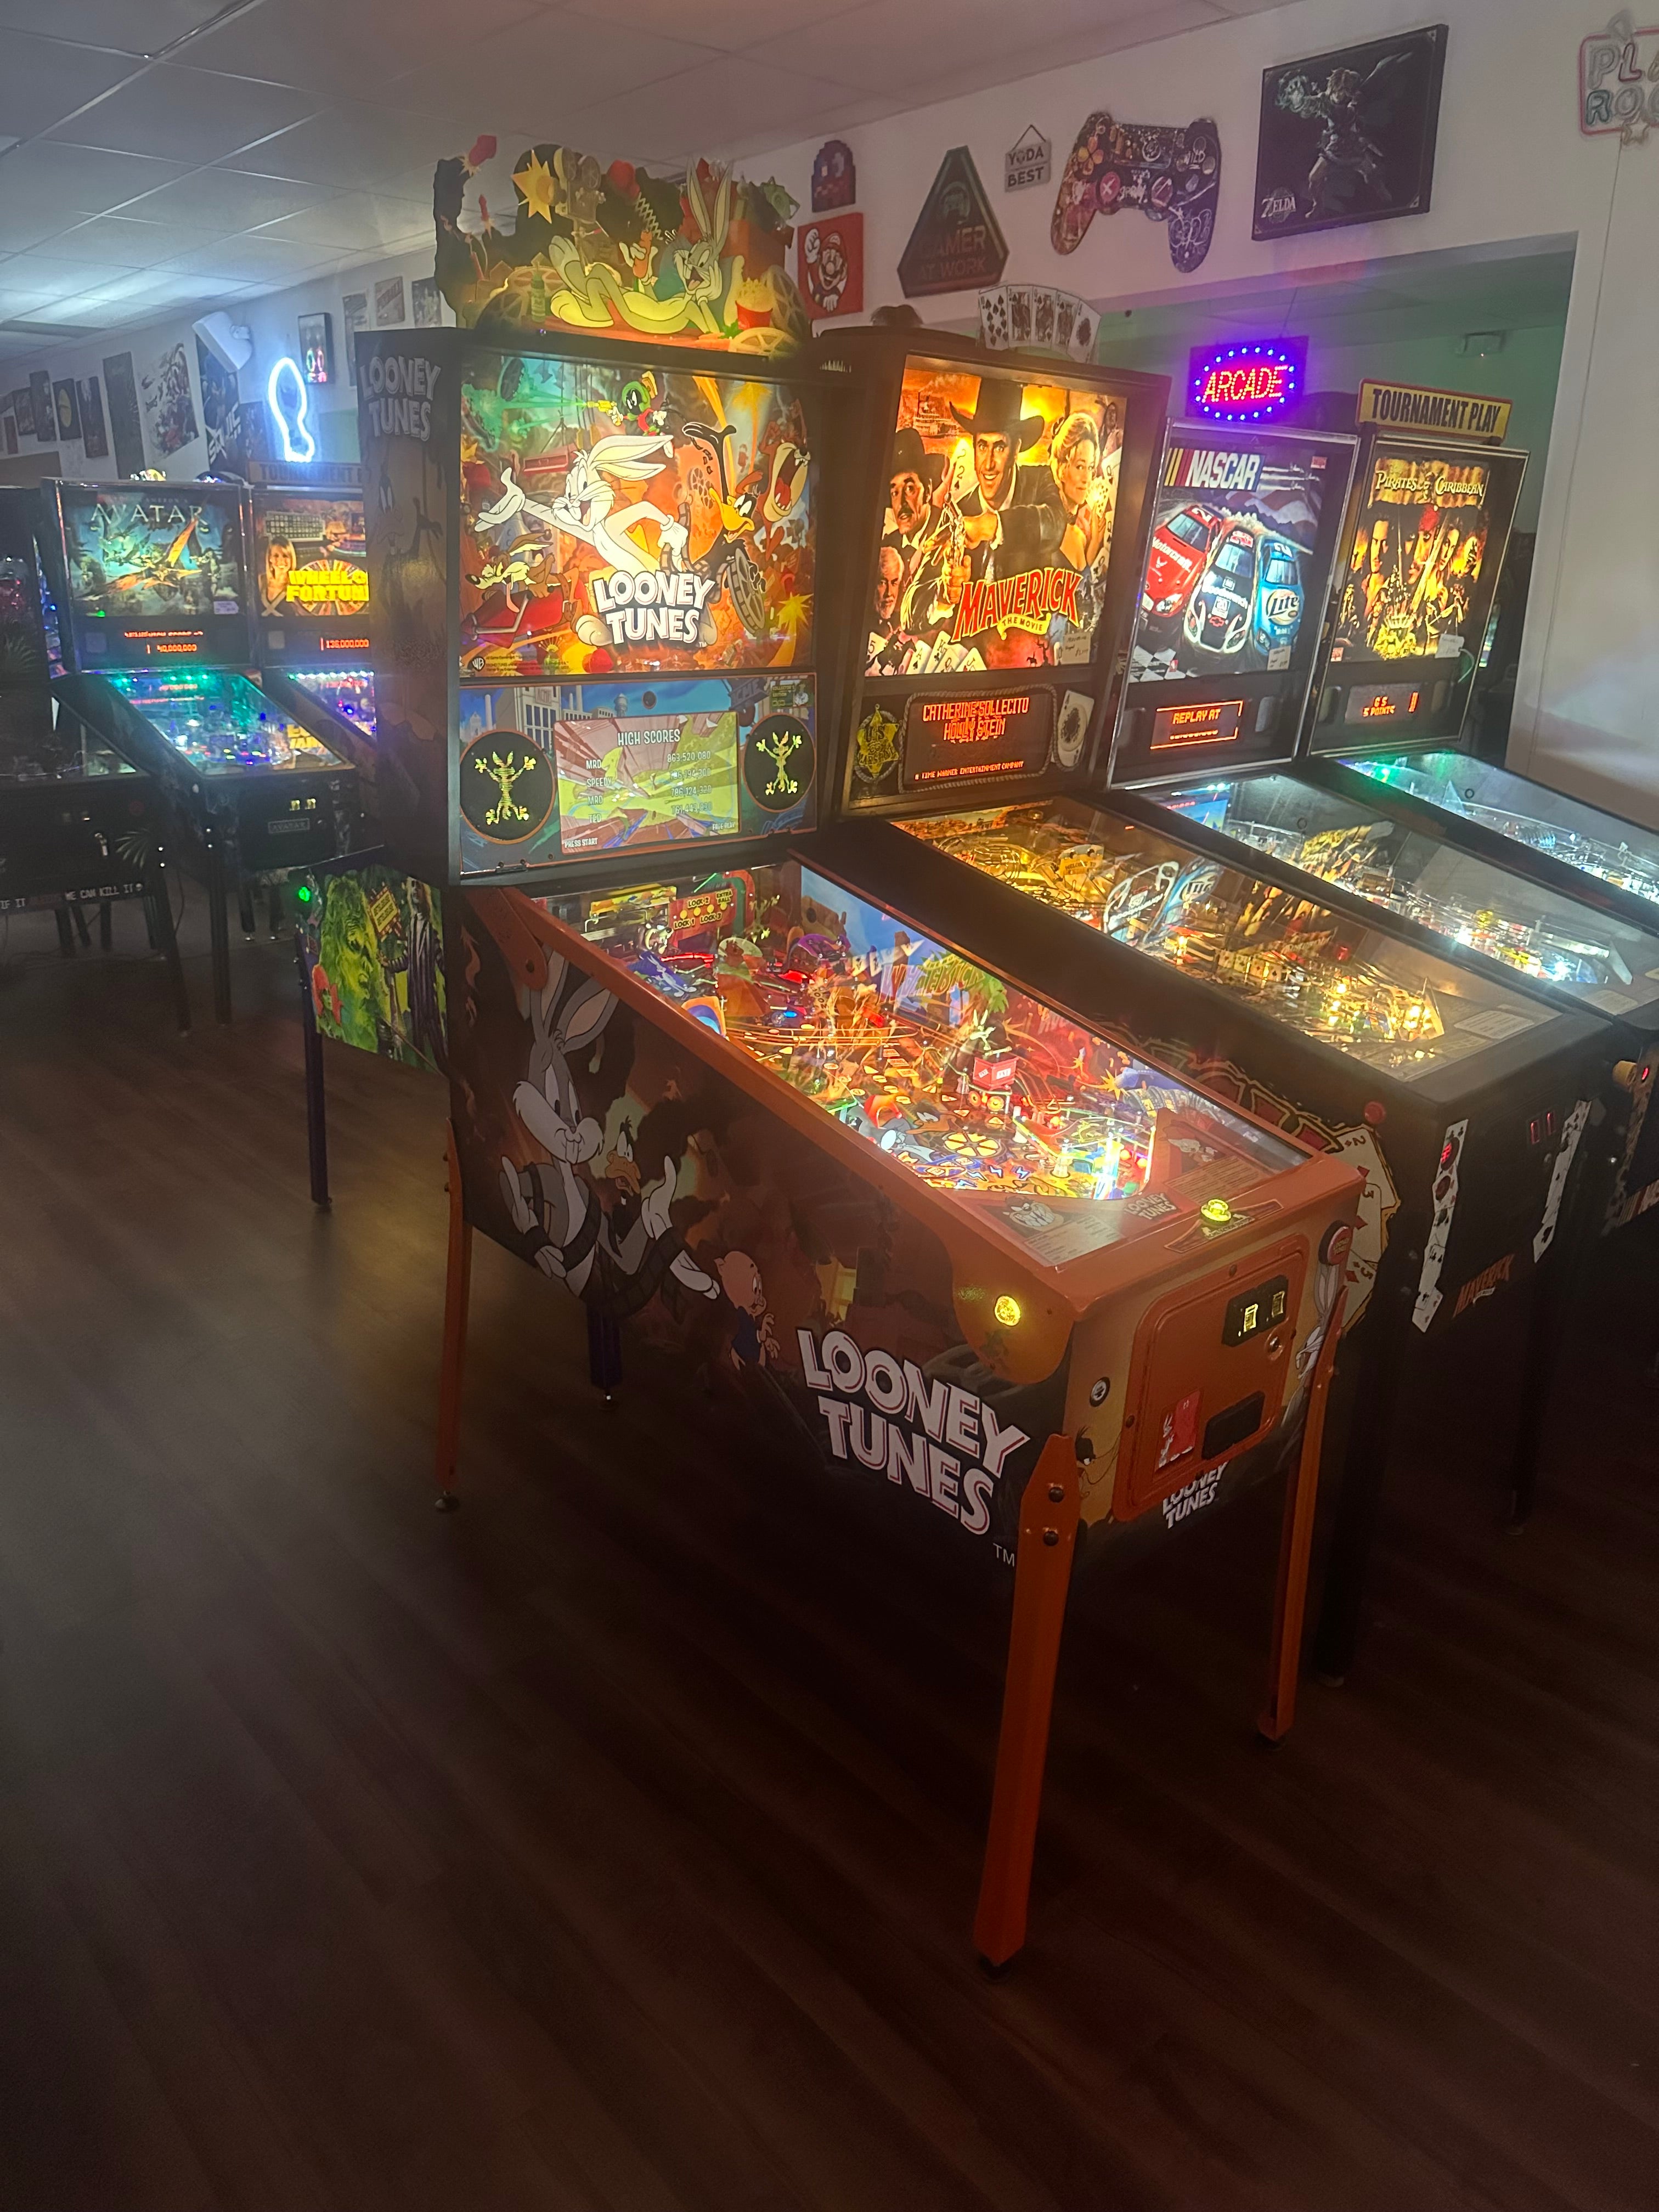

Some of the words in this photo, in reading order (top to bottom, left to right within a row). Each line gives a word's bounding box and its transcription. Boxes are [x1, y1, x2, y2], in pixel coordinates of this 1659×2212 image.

[1008, 146, 1044, 166] YODA
[1007, 167, 1044, 188] BEST
[1261, 197, 1296, 218] ZELDA
[359, 356, 441, 400] LOONEY
[1201, 365, 1288, 403] ARCADE
[368, 398, 431, 441] TUNES
[1372, 388, 1468, 430] TOURNAMENT
[1467, 403, 1501, 433] PLAY
[1185, 449, 1262, 492] NASCAR
[1375, 470, 1418, 492] PIRATES
[1435, 475, 1485, 496] CARIBBEAN
[91, 503, 208, 525] AVATAR
[288, 570, 352, 585] WHEEL
[286, 585, 369, 602] FORTUN
[592, 569, 716, 613] LOONEY
[951, 567, 1084, 643] MAVERICK
[1268, 596, 1299, 618] Lite
[605, 607, 700, 645] TUNES
[1002, 617, 1017, 627] THE
[1019, 618, 1043, 631] MOVIE
[868, 640, 876, 654] 5
[1172, 710, 1208, 724] REPLAY
[1208, 708, 1221, 720] AT
[617, 731, 641, 746] HIGH
[644, 729, 681, 744] SCORES
[586, 759, 602, 770] MRD
[922, 771, 935, 779] TIME
[960, 763, 1002, 775] ENTERTAINMENT
[586, 778, 613, 788] SPEEDY
[588, 796, 603, 805] MRD
[588, 814, 602, 823] TED
[565, 839, 581, 849] PRESS
[582, 837, 598, 847] START
[15, 898, 26, 908] IT
[80, 889, 96, 899] CAN
[99, 885, 120, 896] KILL
[122, 883, 134, 893] IT
[674, 920, 690, 928] LOCK
[701, 914, 716, 922] LOCK
[1123, 1192, 1168, 1215] LOONEY
[1138, 1201, 1177, 1220] TUNES
[797, 1329, 1031, 1479] LOONEY
[817, 1395, 994, 1536] TUNES
[1163, 1460, 1229, 1516] LOONEY
[1165, 1482, 1218, 1529] TUNES
[992, 1543, 1015, 1567] TM
